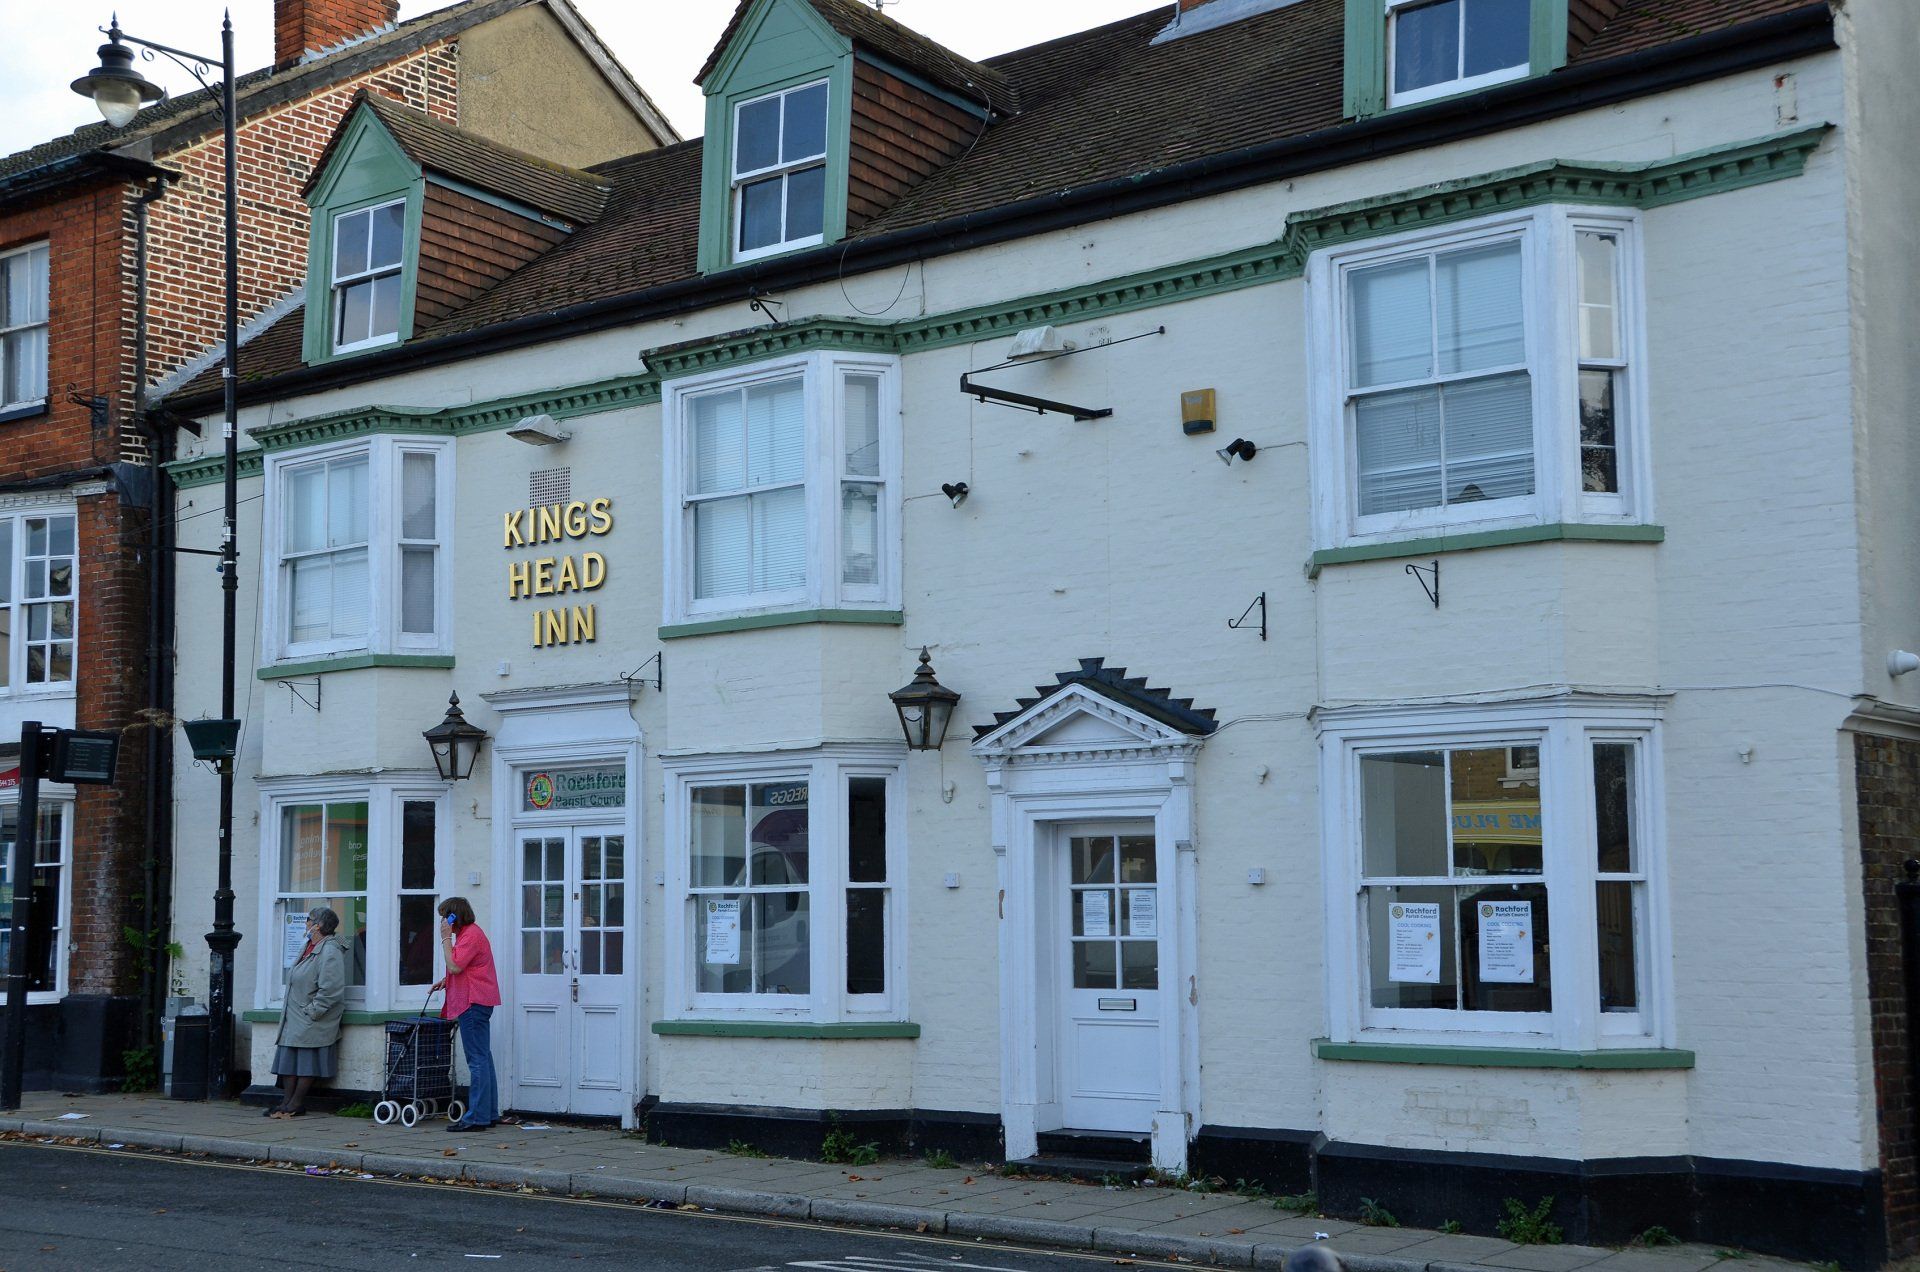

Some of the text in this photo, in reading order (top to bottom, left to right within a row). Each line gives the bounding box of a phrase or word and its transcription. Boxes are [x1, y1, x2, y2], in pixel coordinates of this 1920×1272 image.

[504, 498, 613, 550] KINGS
[509, 552, 607, 600] HEAD
[533, 604, 596, 648] INN
[556, 772, 625, 792] Rochford
[555, 795, 586, 807] Parish
[1405, 907, 1437, 915] Rochford
[1495, 905, 1529, 913] Rochford
